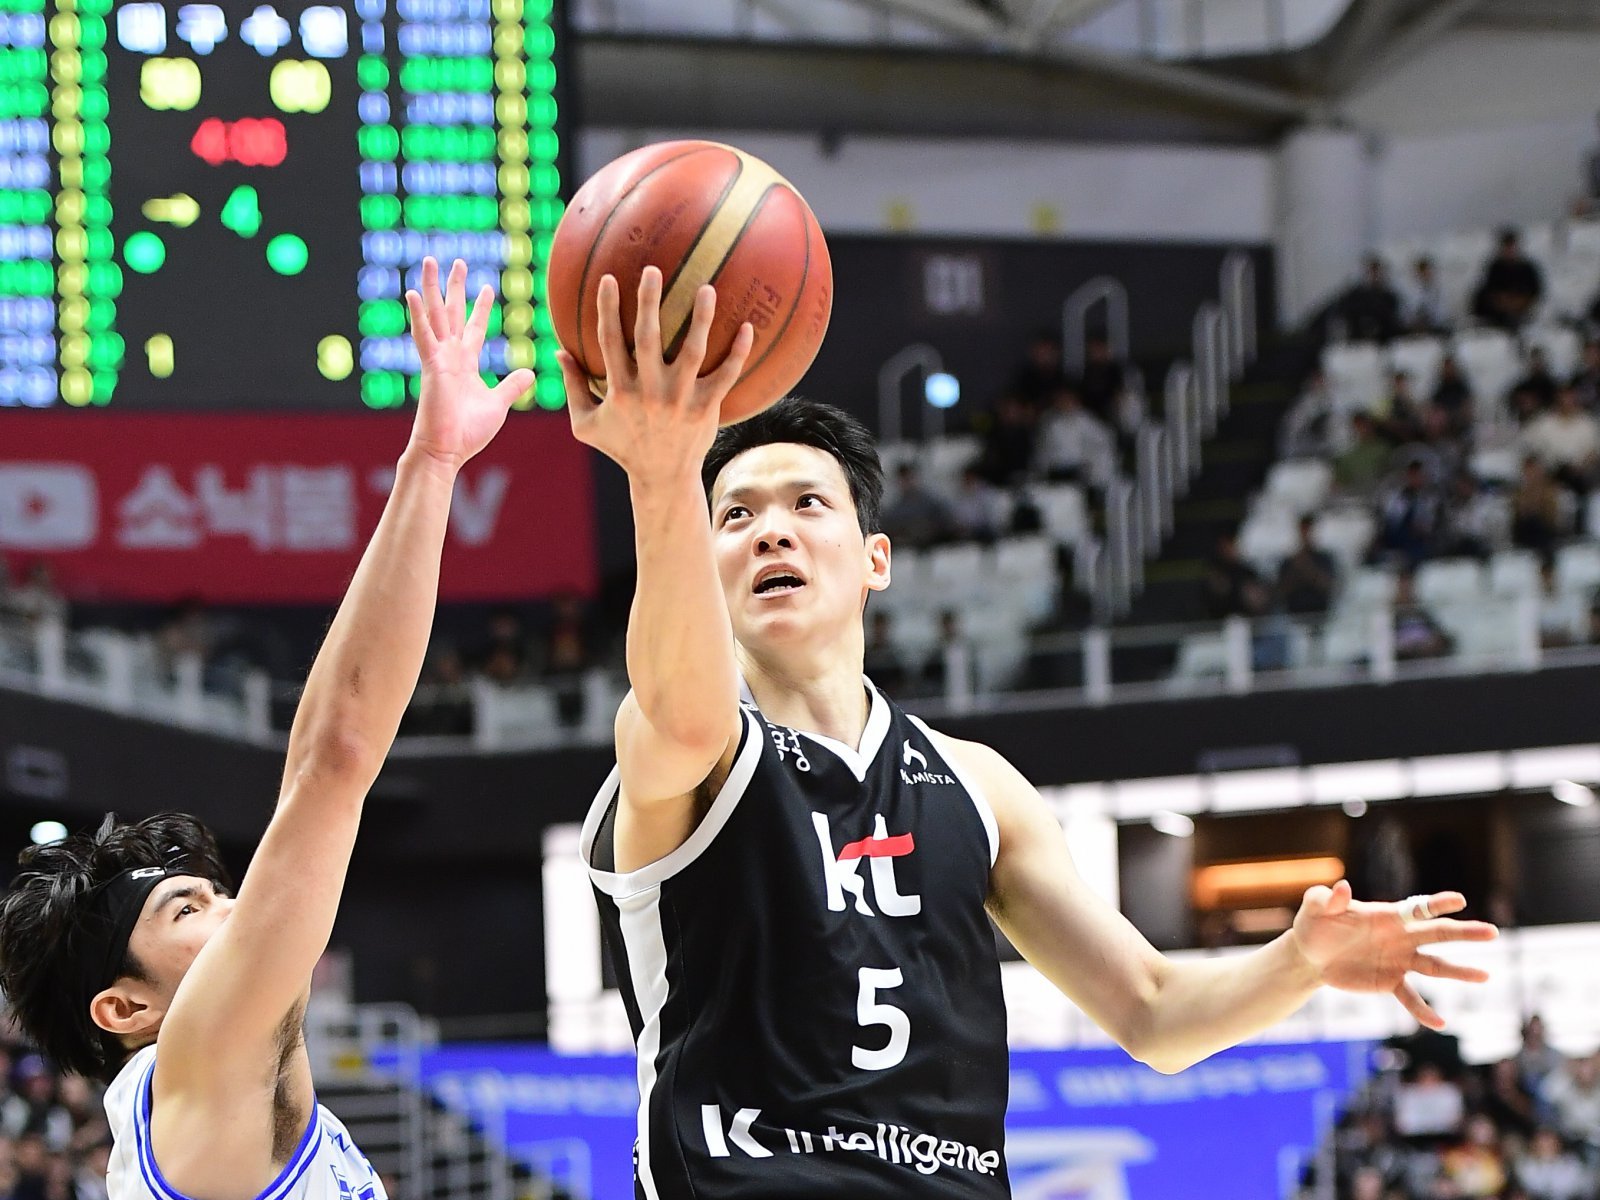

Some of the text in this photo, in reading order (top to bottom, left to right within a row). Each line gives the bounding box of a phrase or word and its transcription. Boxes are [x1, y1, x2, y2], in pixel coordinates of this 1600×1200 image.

[368, 465, 512, 547] V
[811, 811, 921, 918] kt
[851, 965, 911, 1071] 5
[701, 1104, 774, 1158] K
